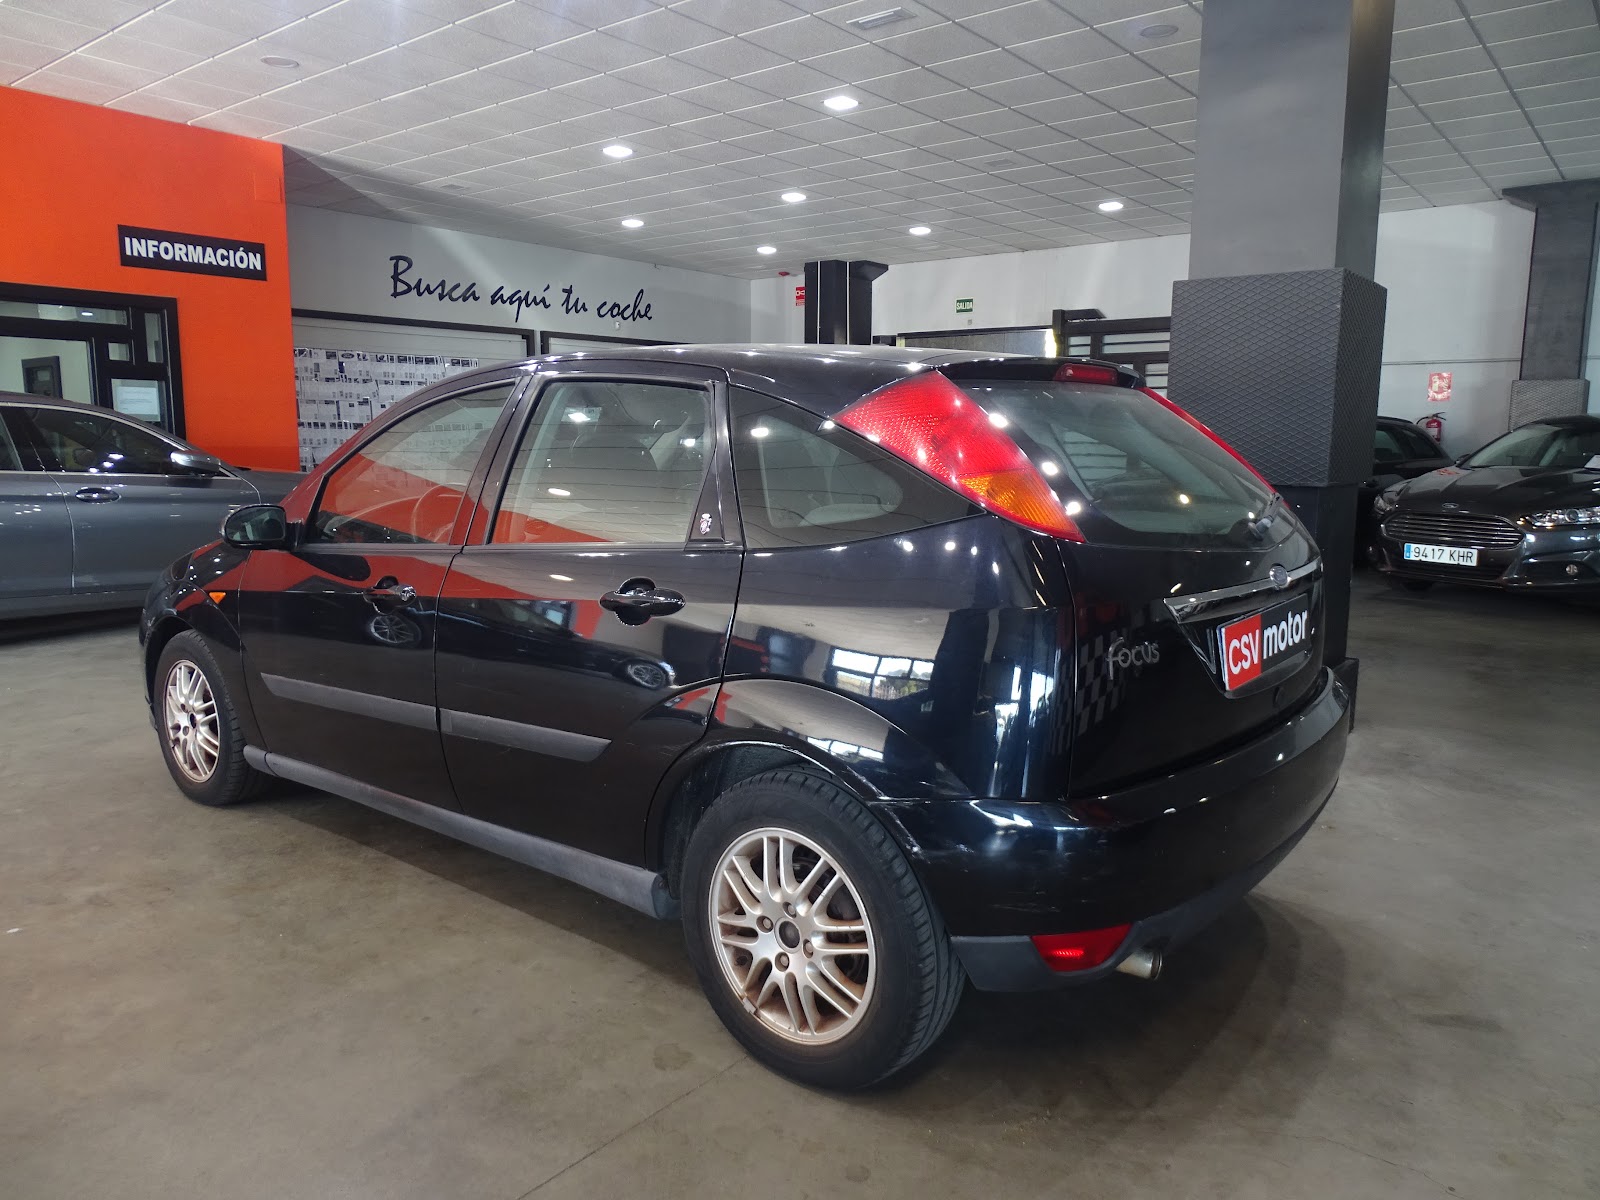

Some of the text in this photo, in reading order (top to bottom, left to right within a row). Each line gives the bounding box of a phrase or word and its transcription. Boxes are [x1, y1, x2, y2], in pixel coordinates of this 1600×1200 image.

[124, 236, 262, 271] INFORMACIÓN
[389, 254, 653, 323] Busca aquí tu coche
[1413, 546, 1474, 563] 9417 KHR
[1228, 609, 1309, 675] CSV motor
